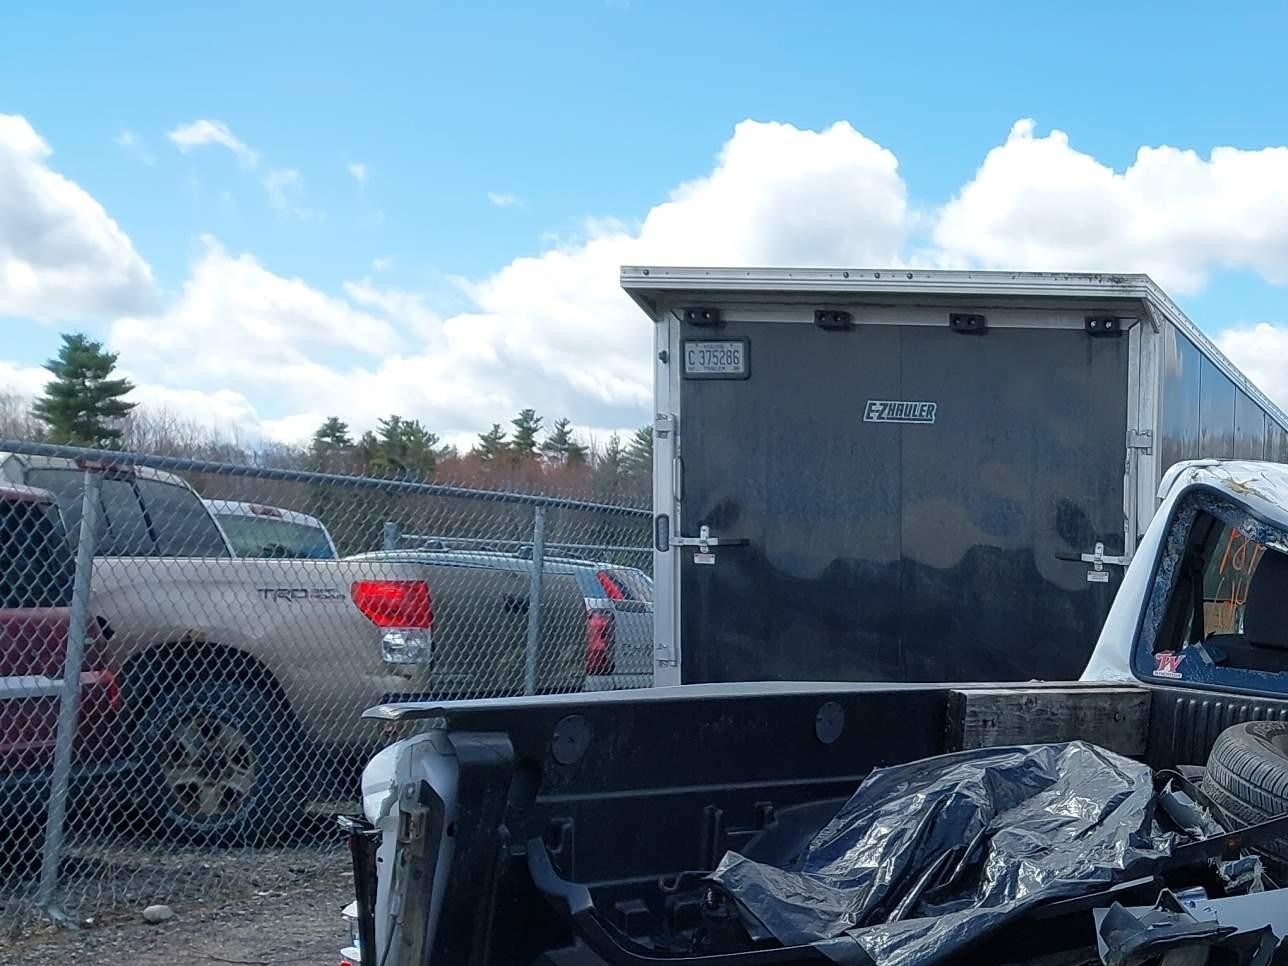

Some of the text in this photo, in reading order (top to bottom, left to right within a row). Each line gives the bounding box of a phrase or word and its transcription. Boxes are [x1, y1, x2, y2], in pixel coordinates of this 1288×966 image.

[688, 349, 740, 366] C 375286
[257, 588, 309, 602] TRD
